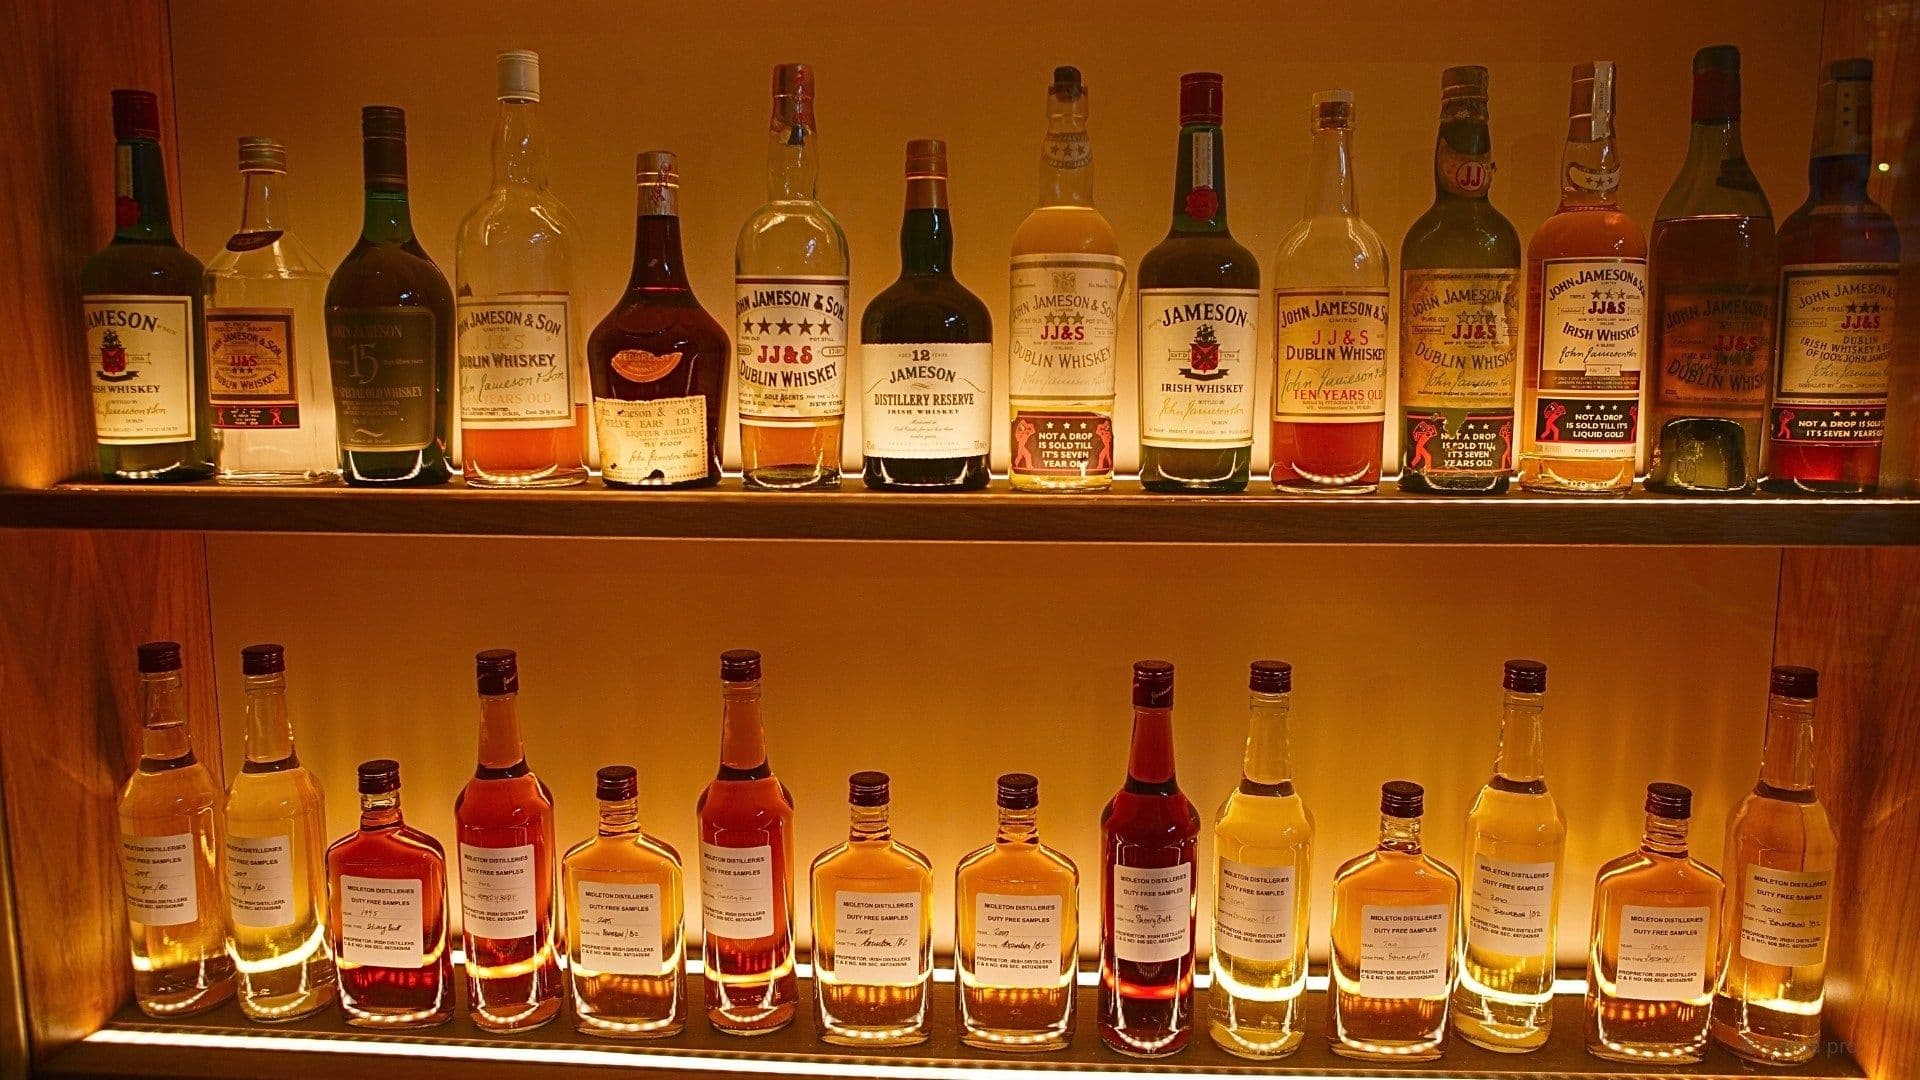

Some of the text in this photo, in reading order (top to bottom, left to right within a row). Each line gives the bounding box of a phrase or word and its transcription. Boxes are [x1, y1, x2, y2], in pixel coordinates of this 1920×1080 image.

[1549, 269, 1634, 301] JOHN JAMESON
[752, 290, 810, 308] JAMESON
[814, 294, 823, 310] &
[1033, 294, 1090, 310] JAMESON
[1091, 299, 1098, 311] &
[1413, 289, 1501, 317] JOHN JAMESON
[1799, 290, 1830, 309] JOHN
[1282, 300, 1372, 328] JOHN JAMESON
[1588, 301, 1626, 314] JJ&S
[1162, 303, 1248, 328] JAMESON
[470, 310, 561, 335] JAMESON & SON
[1841, 316, 1880, 329] JJ&S
[223, 332, 259, 343] JAMESON
[1040, 325, 1084, 340] JJ&S
[1452, 325, 1496, 339] JJ&S
[1563, 322, 1640, 341] IRISH WHISKEY
[1800, 337, 1873, 354] IRISH WHISKEY
[1843, 336, 1879, 344] DUBLIN
[758, 345, 812, 364] JJ&S
[912, 349, 930, 361] 12
[1013, 340, 1111, 368] DUBLIN WHISKEY
[1286, 345, 1335, 360] DUBLIN
[1415, 341, 1466, 369] DUBLIN
[1559, 346, 1584, 364] John
[1806, 349, 1818, 358] OF
[231, 356, 257, 367] JJ&S
[348, 343, 379, 384] 15
[491, 353, 555, 367] WHISKEY
[214, 371, 278, 389] DUBLIN WHISKEY
[740, 359, 837, 388] DUBLIN WHISKEY
[889, 365, 956, 383] JAMESON
[109, 385, 160, 393] WHISKEY
[1161, 384, 1244, 393] IRISH WHISKEY
[1294, 389, 1383, 400] TEN YEARS OLD
[780, 394, 804, 402] AGENTS
[874, 393, 974, 406] DISTILLERY RESERVE
[664, 427, 698, 435] WHISKEY
[1043, 460, 1067, 468] YEAR
[489, 855, 528, 863] DISTILLERIES
[1480, 864, 1510, 877] MIDLETON
[1121, 876, 1149, 884] MIDLETON
[1483, 878, 1498, 887] DUTY
[1754, 875, 1788, 886] MIDLETON
[348, 885, 375, 893] MIDLETON
[1158, 887, 1183, 896] SAMPLES
[1757, 889, 1774, 897] DUTY
[1761, 905, 1782, 914] 2010
